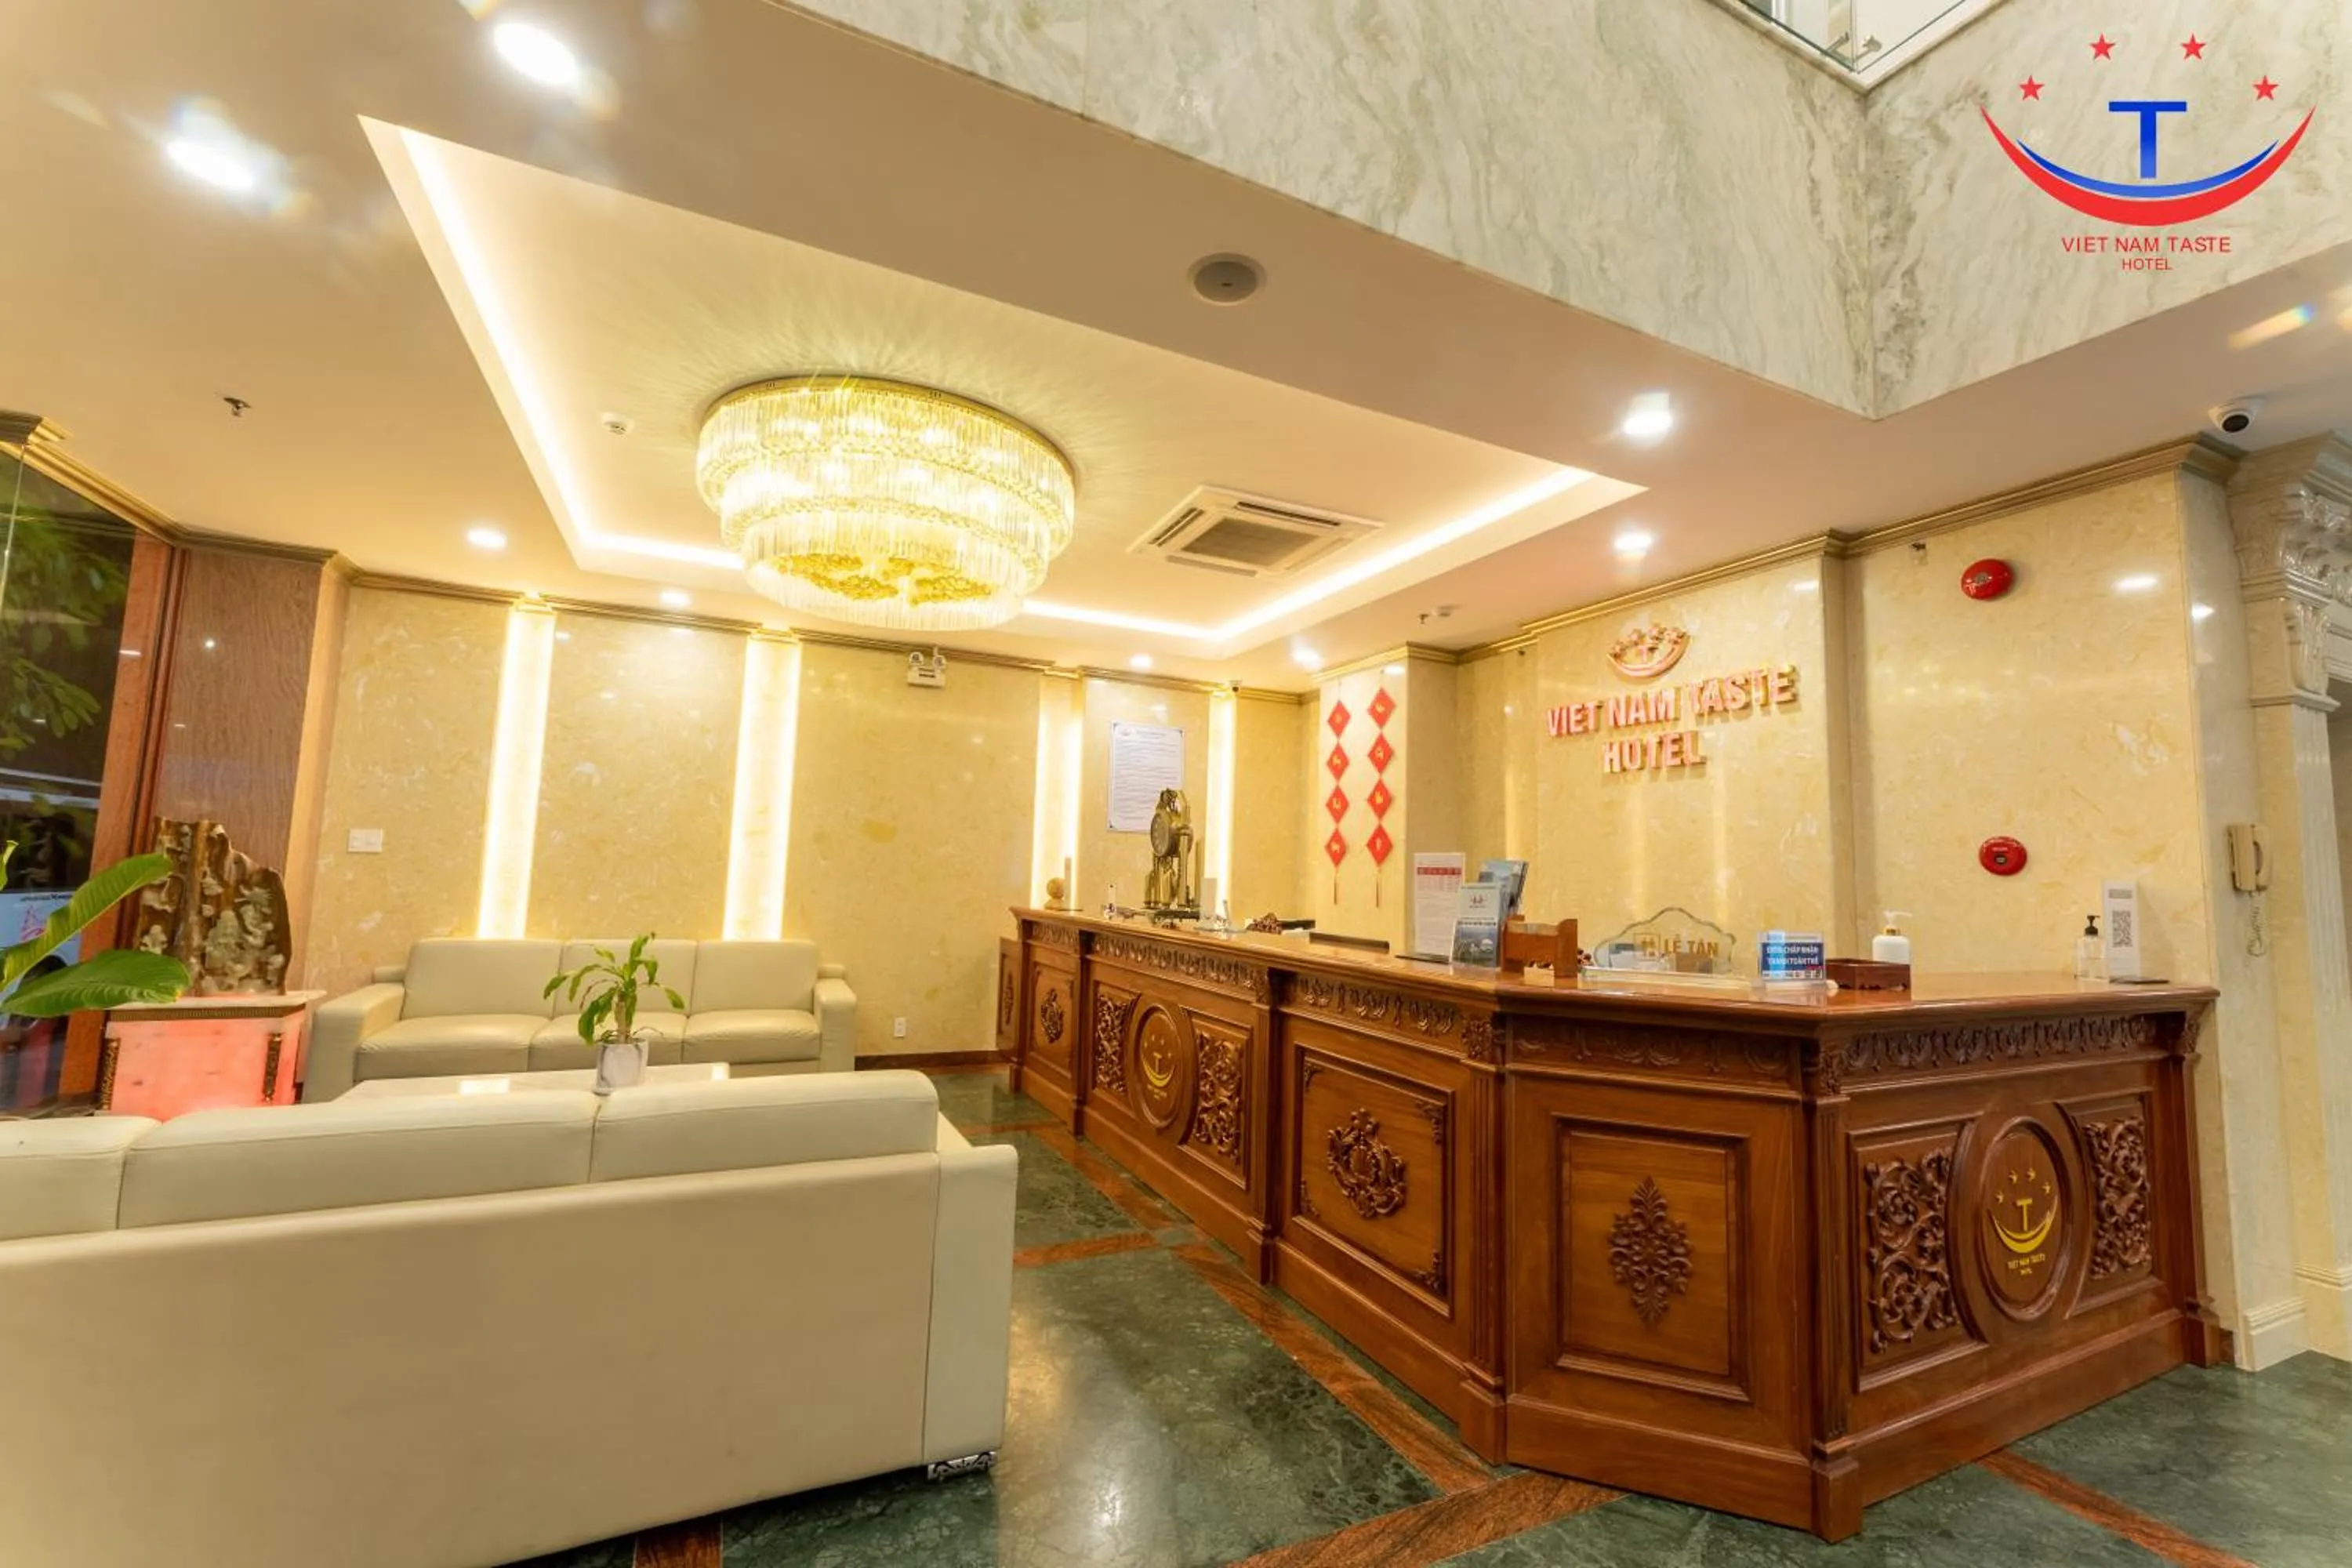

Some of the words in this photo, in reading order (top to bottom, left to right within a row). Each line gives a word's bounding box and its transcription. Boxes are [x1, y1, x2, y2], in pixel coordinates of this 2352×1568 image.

[1547, 700, 1601, 737] VIET
[1608, 686, 1679, 728] NAM
[1688, 663, 1798, 715] TASTE
[1602, 731, 1707, 773] HOTEL
